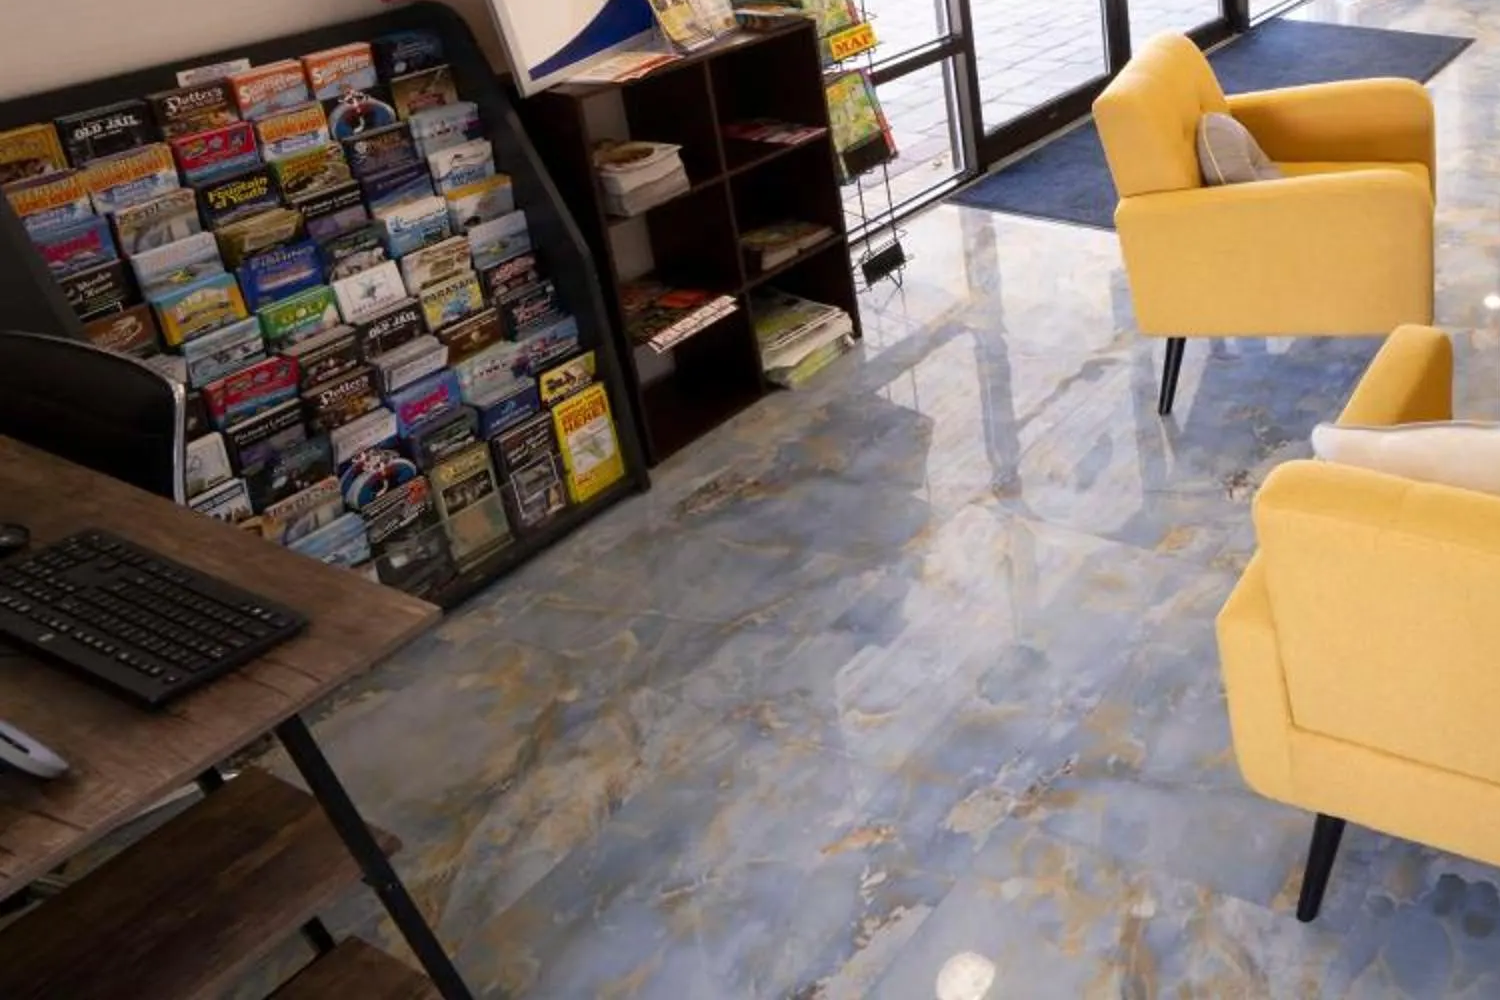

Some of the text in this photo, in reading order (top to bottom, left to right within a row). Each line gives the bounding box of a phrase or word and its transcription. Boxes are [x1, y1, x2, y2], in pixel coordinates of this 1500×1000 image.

[75, 114, 139, 140] OLD JAIL
[208, 175, 269, 204] Fountain
[228, 185, 269, 204] Youth
